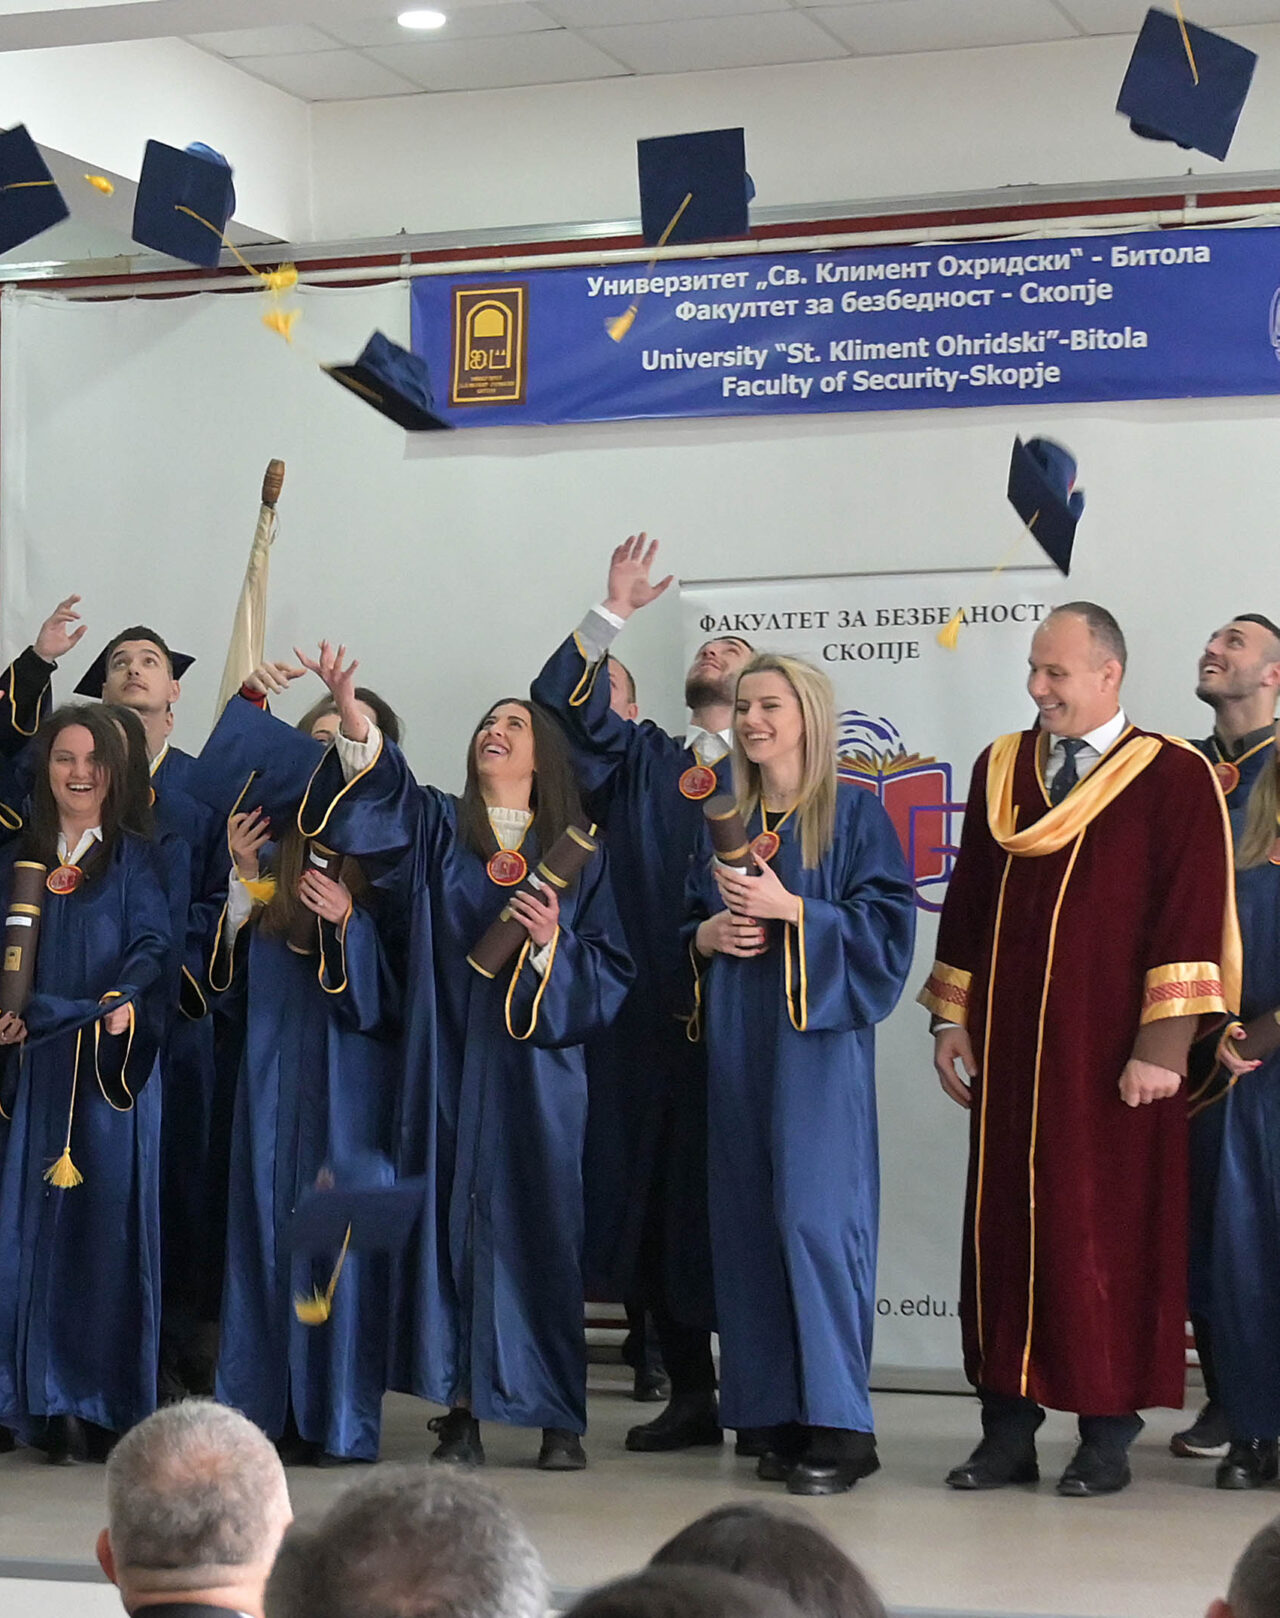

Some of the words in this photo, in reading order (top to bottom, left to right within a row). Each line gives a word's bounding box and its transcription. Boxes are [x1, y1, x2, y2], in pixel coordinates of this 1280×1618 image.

[586, 271, 750, 298] Универзитет
[815, 261, 932, 284] Климент
[1111, 245, 1211, 268] Битола
[675, 299, 800, 324] Факултет
[804, 297, 834, 315] за
[841, 288, 995, 313] безбедност
[1019, 278, 1113, 306] Скопје
[641, 345, 769, 371] University
[829, 337, 930, 362] Kliment
[722, 373, 814, 399] Faculty
[819, 370, 848, 393] of
[852, 361, 1061, 392] Security-Skopje
[699, 611, 830, 633] ФАКУЛТЕТ
[838, 610, 867, 628] ЗА
[822, 641, 920, 665] СКОПЈЕ
[876, 1293, 962, 1317] o.edu.
